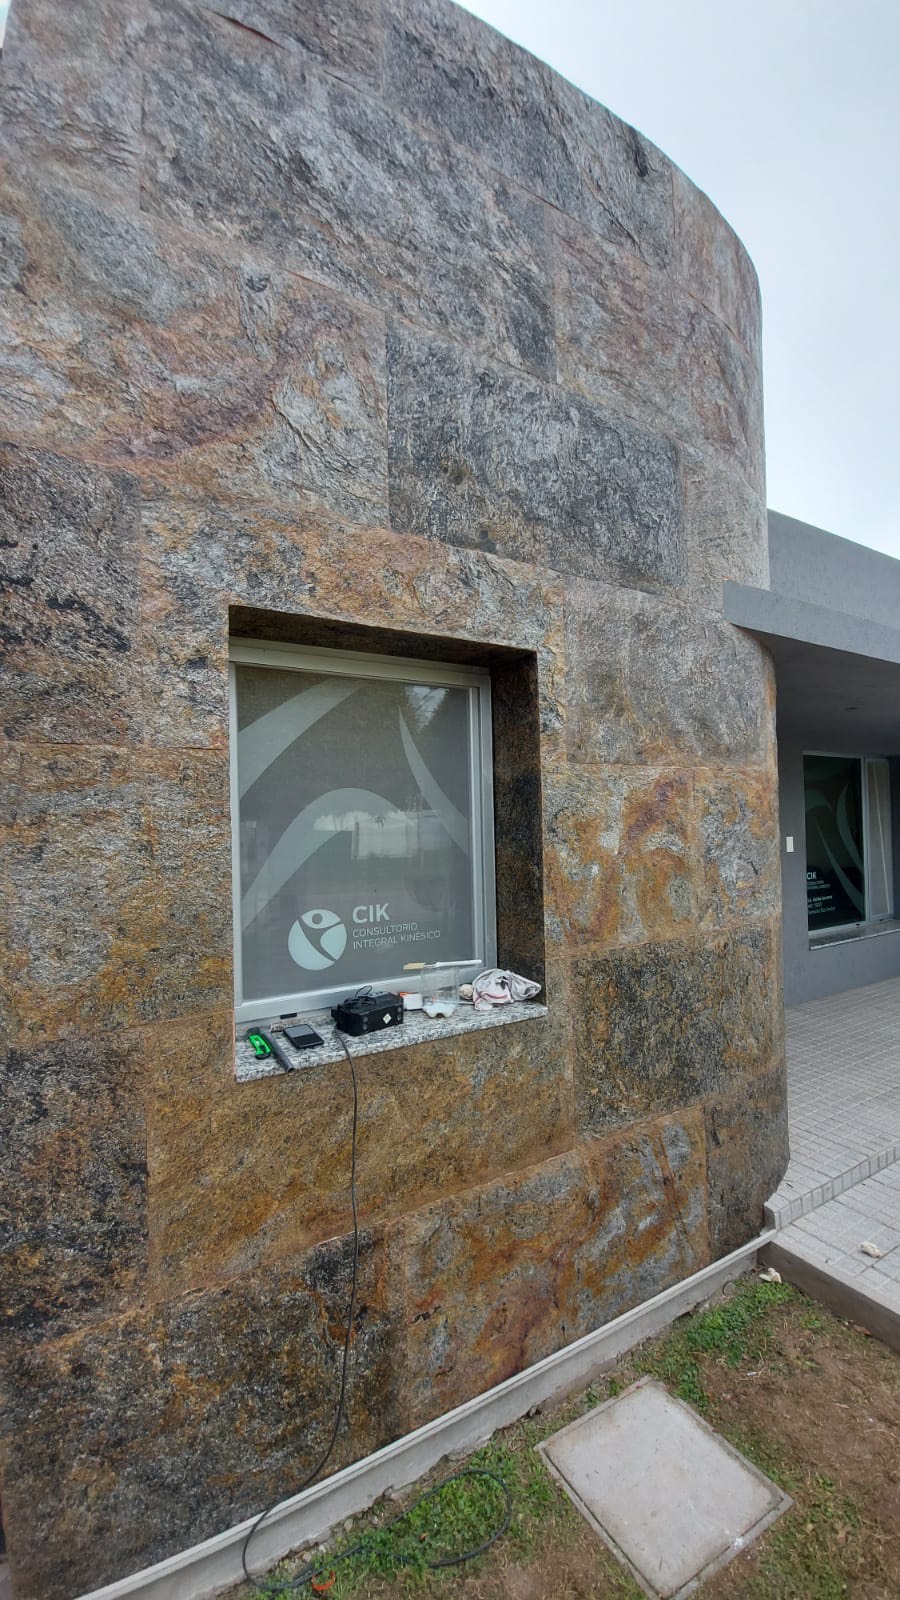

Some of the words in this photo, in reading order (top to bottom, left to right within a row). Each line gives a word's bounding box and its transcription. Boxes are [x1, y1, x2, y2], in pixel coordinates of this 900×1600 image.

[352, 903, 390, 924] CIK
[352, 922, 418, 938] CONSULTORIO
[353, 935, 398, 950] INTEGRAL
